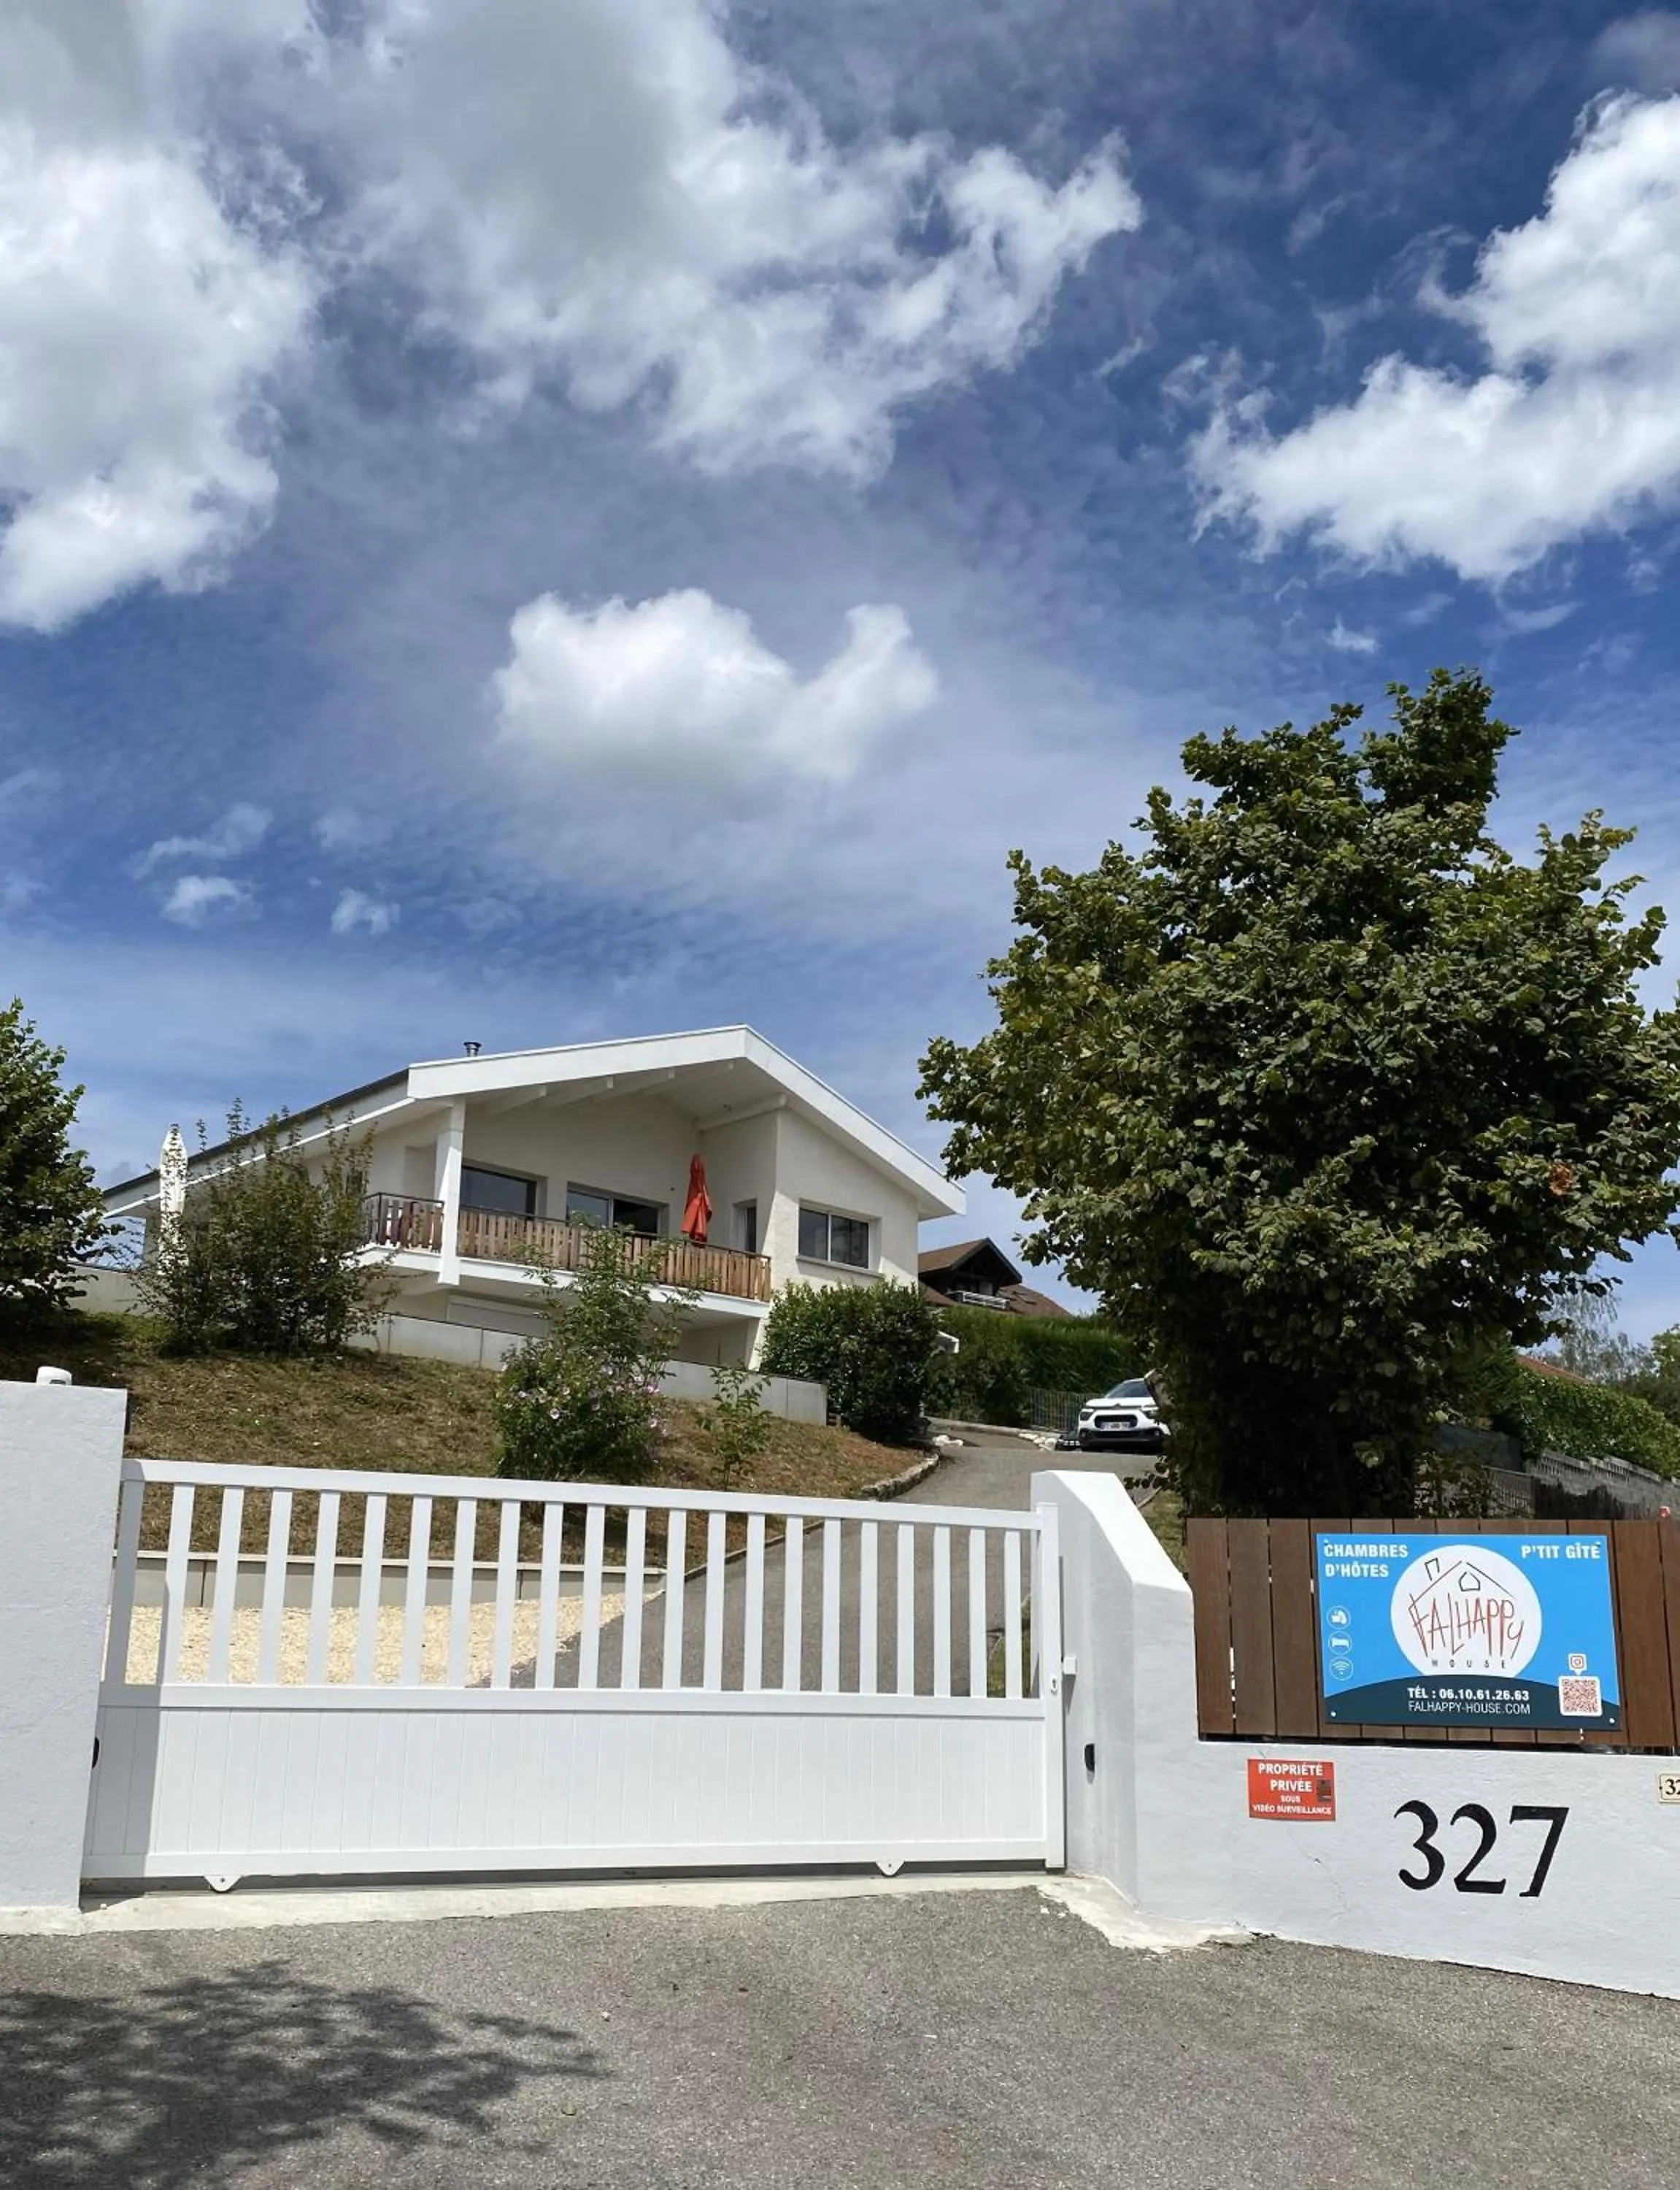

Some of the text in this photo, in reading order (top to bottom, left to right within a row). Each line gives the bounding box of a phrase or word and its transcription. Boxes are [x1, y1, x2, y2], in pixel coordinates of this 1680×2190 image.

[1324, 1543, 1409, 1558] CHAMBRES
[1521, 1545, 1560, 1559] P'TIT
[1325, 1561, 1389, 1577] D'HÔTES
[1431, 1659, 1506, 1668] HOUSE
[1408, 1700, 1531, 1715] FALHAPPY-HOUSE.COM
[1258, 1762, 1323, 1776] PROPRIÉTÉ
[1270, 1778, 1313, 1792] PRIVÉE
[1280, 1795, 1301, 1803] SOUS
[1252, 1803, 1332, 1815] VIDÉO SURVEILLANCE
[1393, 1799, 1570, 1898] 327
